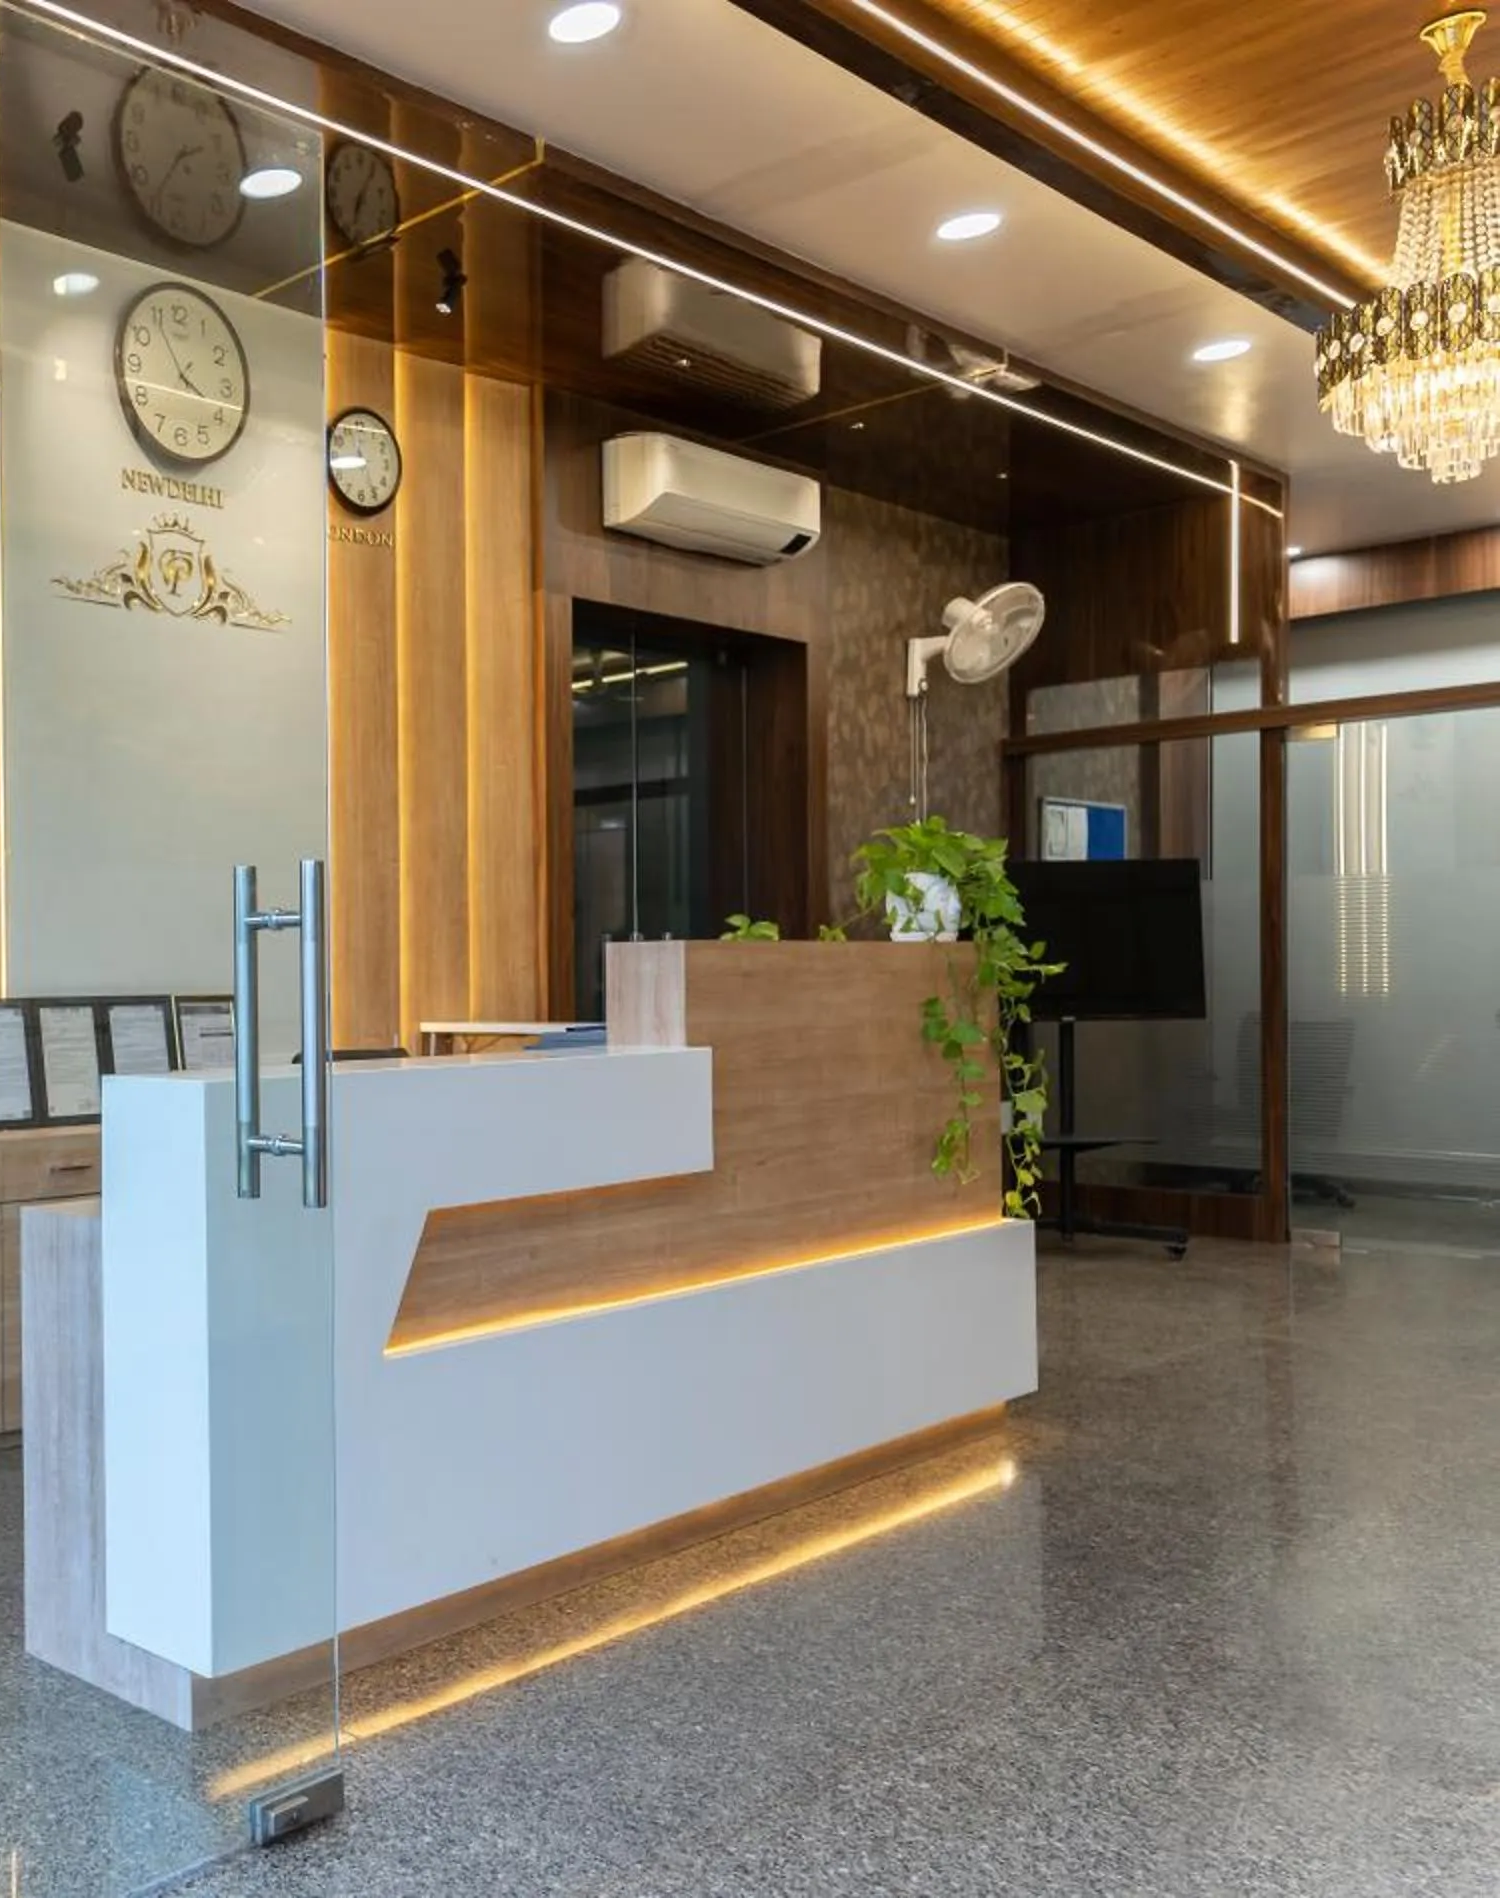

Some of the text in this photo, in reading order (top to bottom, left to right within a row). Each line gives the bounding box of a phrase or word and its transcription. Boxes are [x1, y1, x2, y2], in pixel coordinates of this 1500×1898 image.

[171, 305, 188, 326] 12
[132, 325, 151, 347] 10
[126, 353, 142, 373] 9
[213, 345, 229, 367] 2
[134, 384, 148, 406] 8
[220, 378, 233, 399] 3
[154, 412, 166, 433] 7
[213, 407, 224, 427] 4
[173, 426, 188, 447] 6
[197, 425, 211, 446] 5
[328, 525, 395, 550] ONDON
